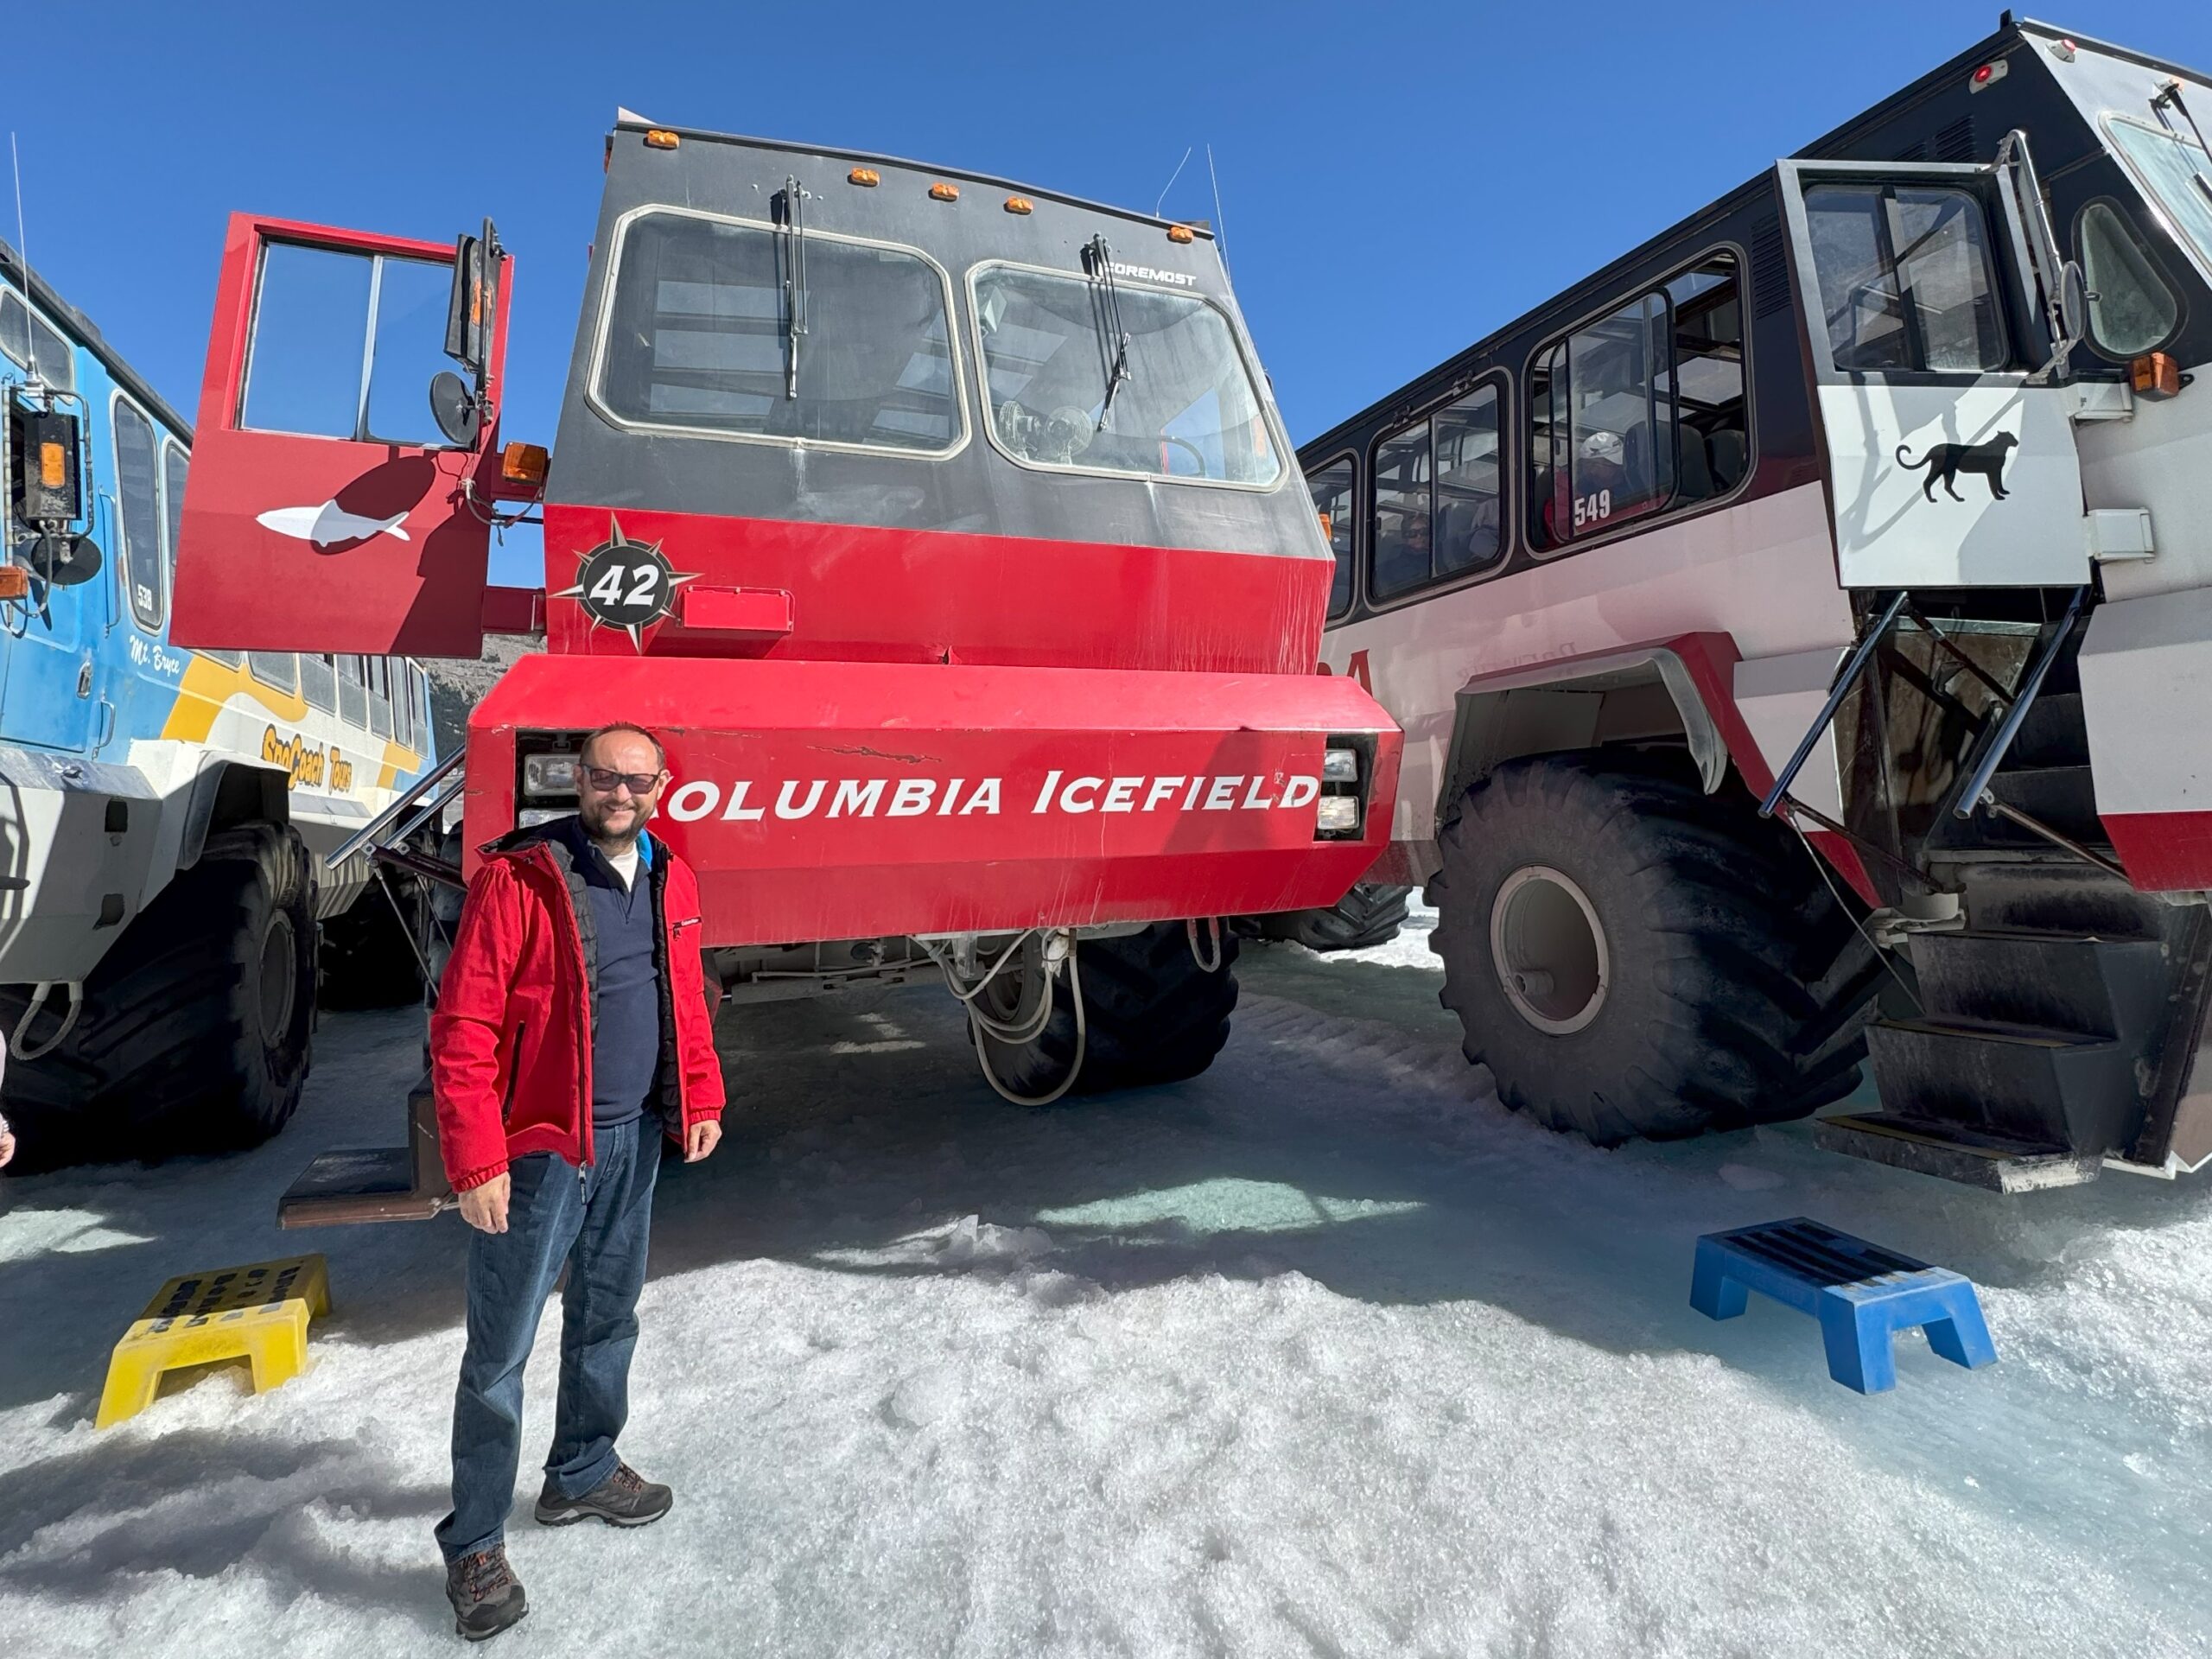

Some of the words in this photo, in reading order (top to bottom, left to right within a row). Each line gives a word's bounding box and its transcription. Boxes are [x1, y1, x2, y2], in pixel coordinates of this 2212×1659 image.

[1574, 489, 1611, 527] 549
[588, 564, 659, 607] 42
[129, 634, 151, 666] Mt.
[152, 645, 181, 677] Bryce
[328, 746, 353, 796] Tours
[650, 777, 1003, 822] OLUMBIA
[1031, 770, 1319, 813] ICEFIELD
